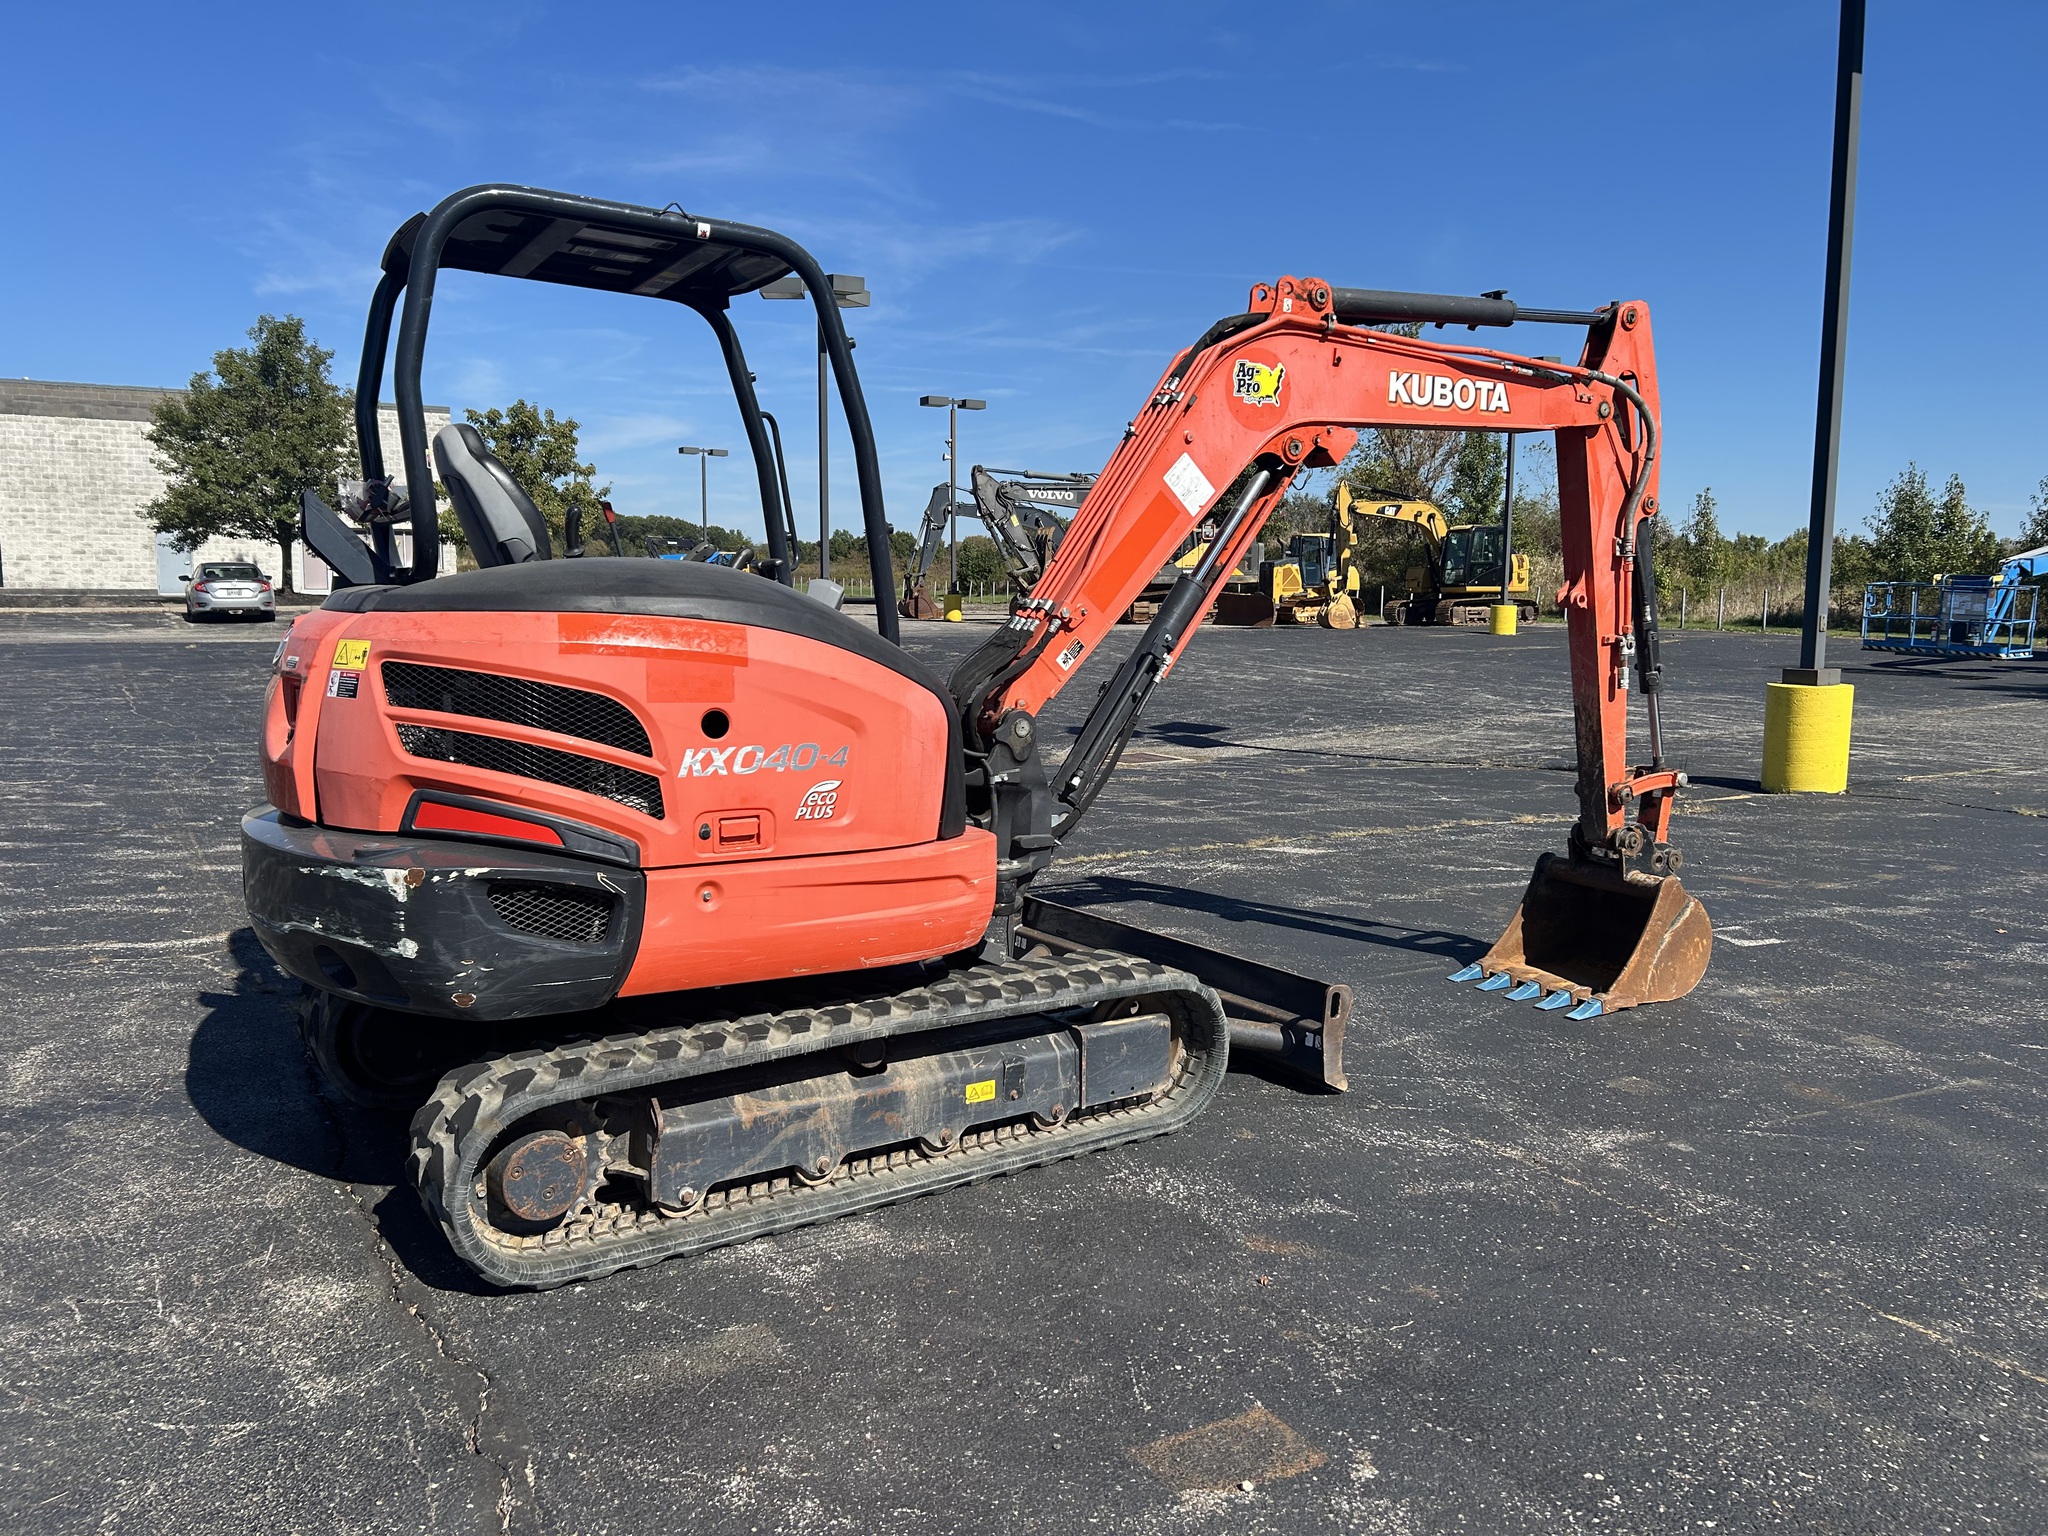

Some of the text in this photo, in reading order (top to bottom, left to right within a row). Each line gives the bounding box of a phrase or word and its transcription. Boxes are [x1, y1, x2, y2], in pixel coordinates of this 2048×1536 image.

[1236, 362, 1260, 381] Ag-
[1236, 379, 1260, 393] Pro
[1388, 371, 1511, 413] KUBOTA
[1027, 489, 1074, 500] VOLVO
[1384, 505, 1397, 516] CAT
[677, 743, 849, 778] KX040-4
[807, 791, 838, 806] eco
[794, 804, 835, 821] PLUS
